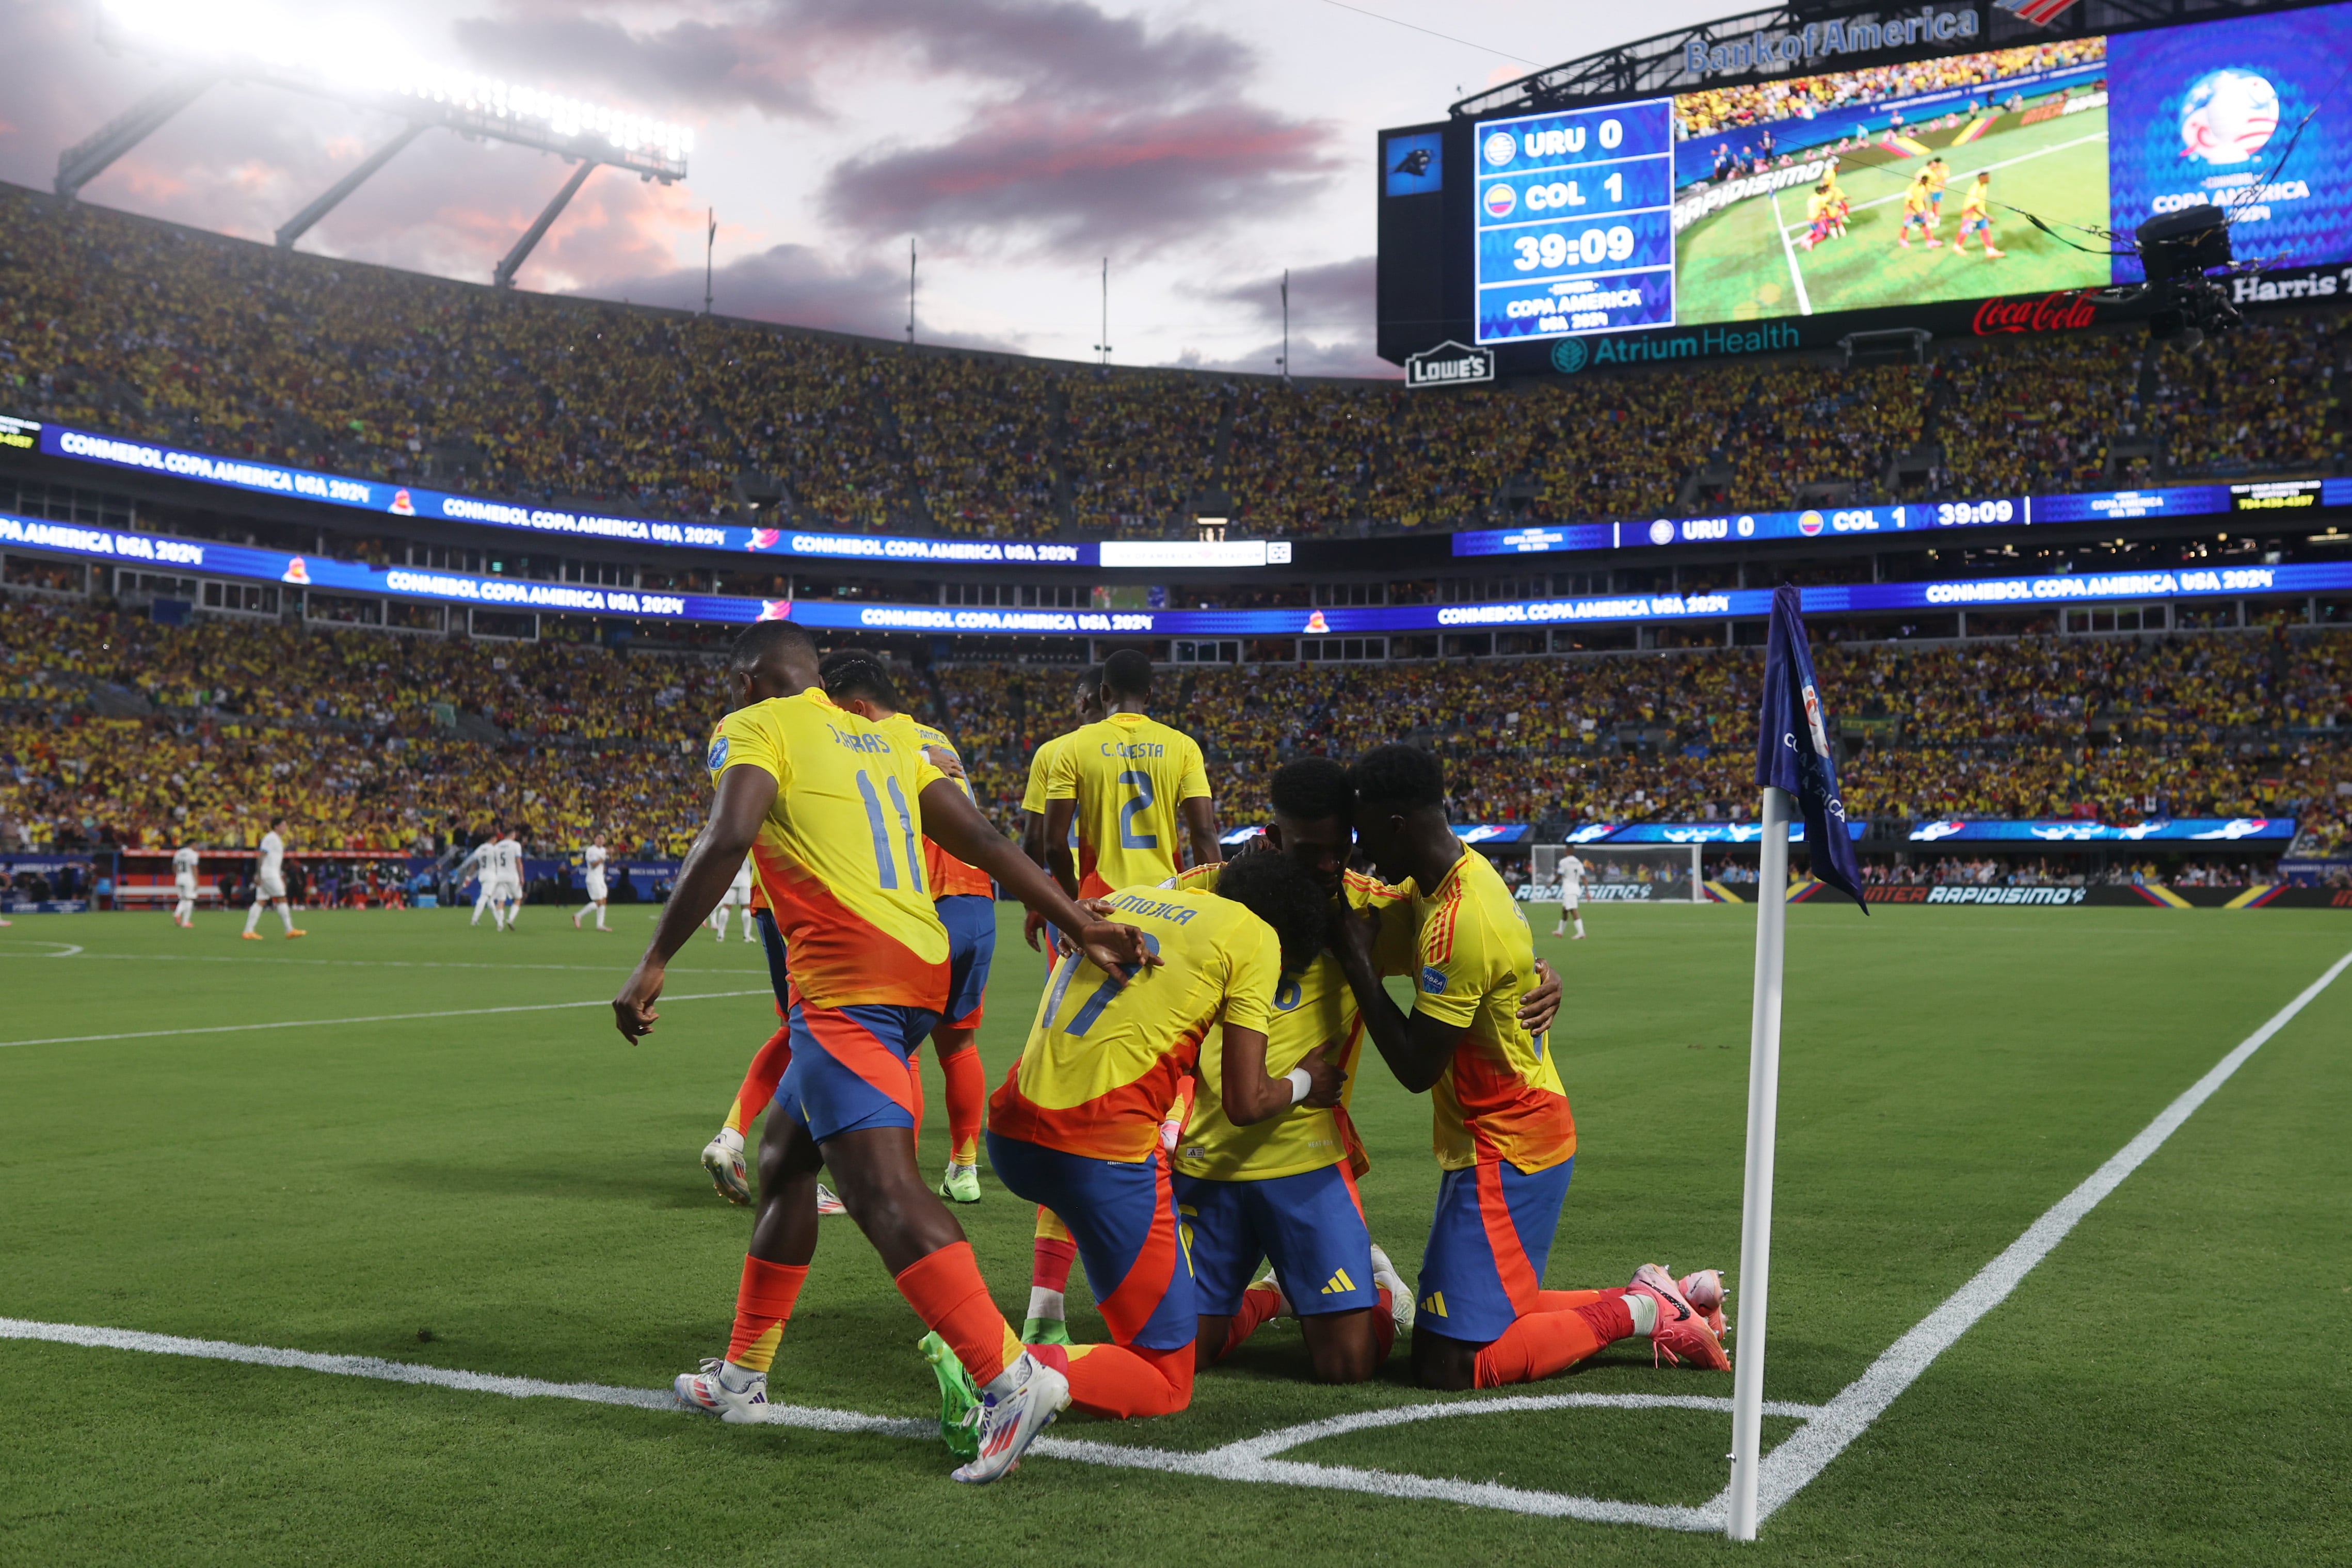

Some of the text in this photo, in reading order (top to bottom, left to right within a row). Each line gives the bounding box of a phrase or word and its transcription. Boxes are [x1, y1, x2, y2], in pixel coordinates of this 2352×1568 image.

[1686, 6, 1979, 74] Bank of America
[1524, 119, 1623, 157] URU 0
[1525, 172, 1622, 211] COL 1
[2152, 191, 2210, 213] COPA
[1513, 226, 1634, 271] 39:09
[1506, 289, 1642, 318] COPA AMERICA
[2232, 273, 2337, 304] Harris
[1539, 311, 1609, 332] USA 2024
[1972, 288, 2102, 336] Coca-Cola
[1594, 322, 1799, 364] Atrium Health
[1415, 355, 1485, 382] LOWE'S
[60, 431, 165, 470] CONMEBOL
[164, 452, 212, 479] COPA
[213, 461, 293, 492] AMERICA
[295, 474, 327, 498] USA
[329, 479, 370, 503] 2024
[442, 498, 726, 546] CONMEBOL COPA AMERICA USA 2024
[1682, 516, 1755, 540] URU 0
[1832, 500, 2013, 531] COL 1 39:09
[0, 519, 203, 565] PA AMERICA USA 2024
[792, 535, 1078, 562] CONMEBOL COPA AMERICA USA 2024
[387, 571, 684, 615] CONMEBOL COPA AMERICA USA 2024
[1926, 569, 2273, 603] CONMEBOL COPA AMERICA USA 2024
[861, 608, 1153, 631] CONMEBOL COPA AMERICA USA 2024
[1437, 595, 1728, 625] CONMEBOL COPA AMERICA USA 2024
[1118, 770, 1158, 849] 2
[856, 769, 924, 894] 11
[1864, 886, 2070, 904] INTER RAPIDISIMO
[1424, 973, 1443, 987] VIBRA
